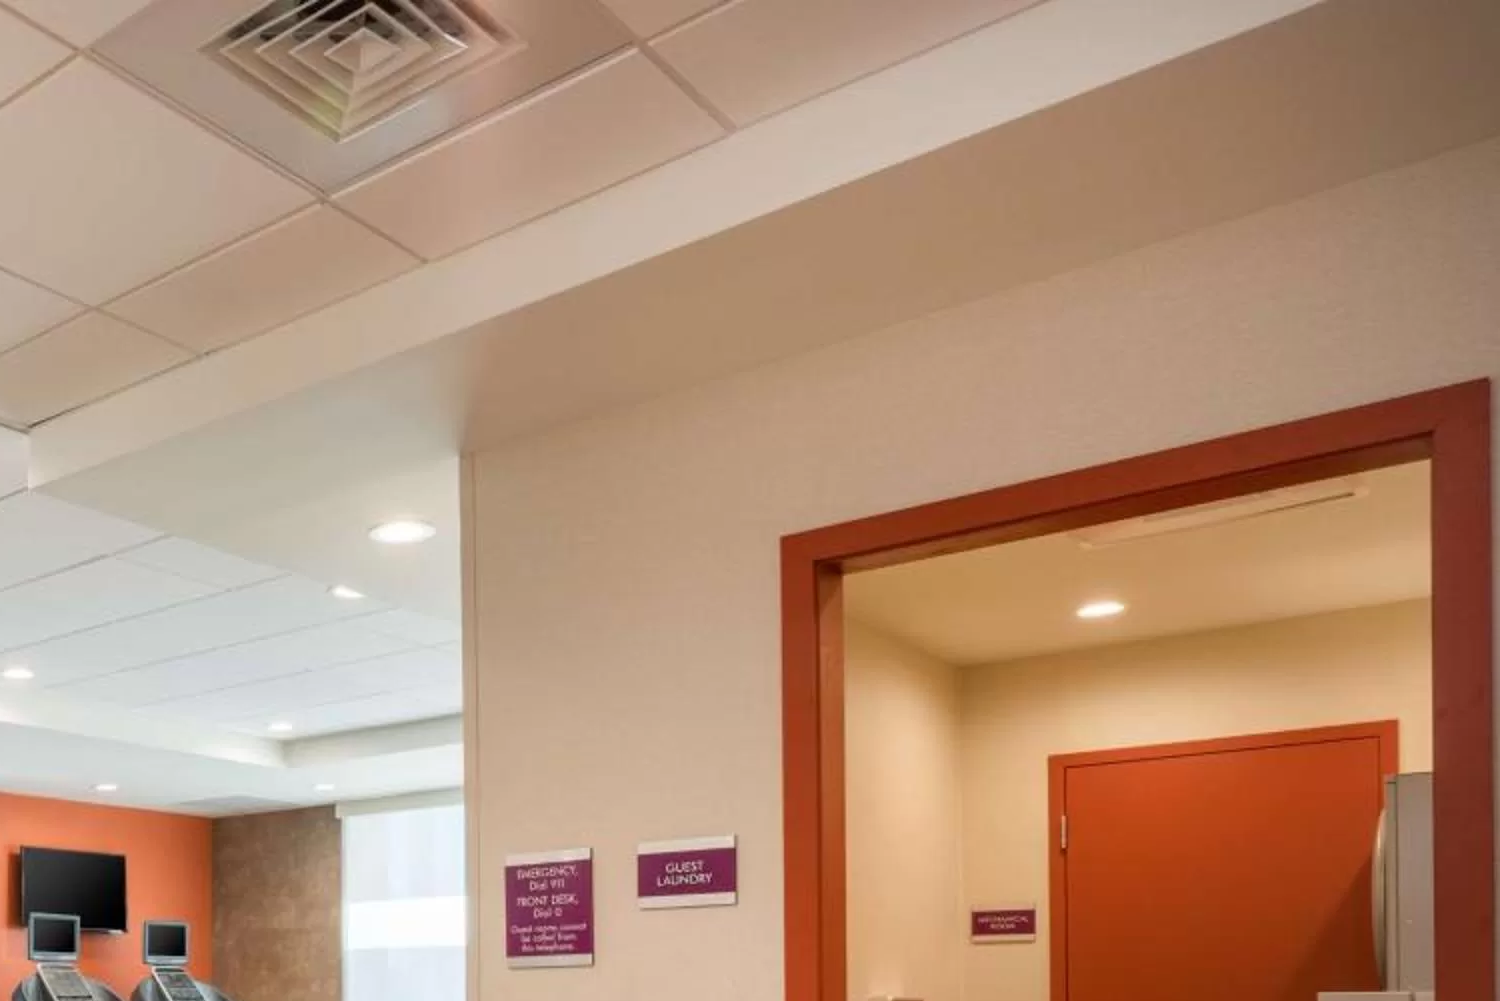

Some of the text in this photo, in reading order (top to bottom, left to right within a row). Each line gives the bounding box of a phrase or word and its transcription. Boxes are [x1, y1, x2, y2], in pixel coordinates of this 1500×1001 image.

[665, 860, 704, 874] GUEST
[656, 872, 713, 888] LAUNDRY
[516, 895, 548, 907] FRONT
